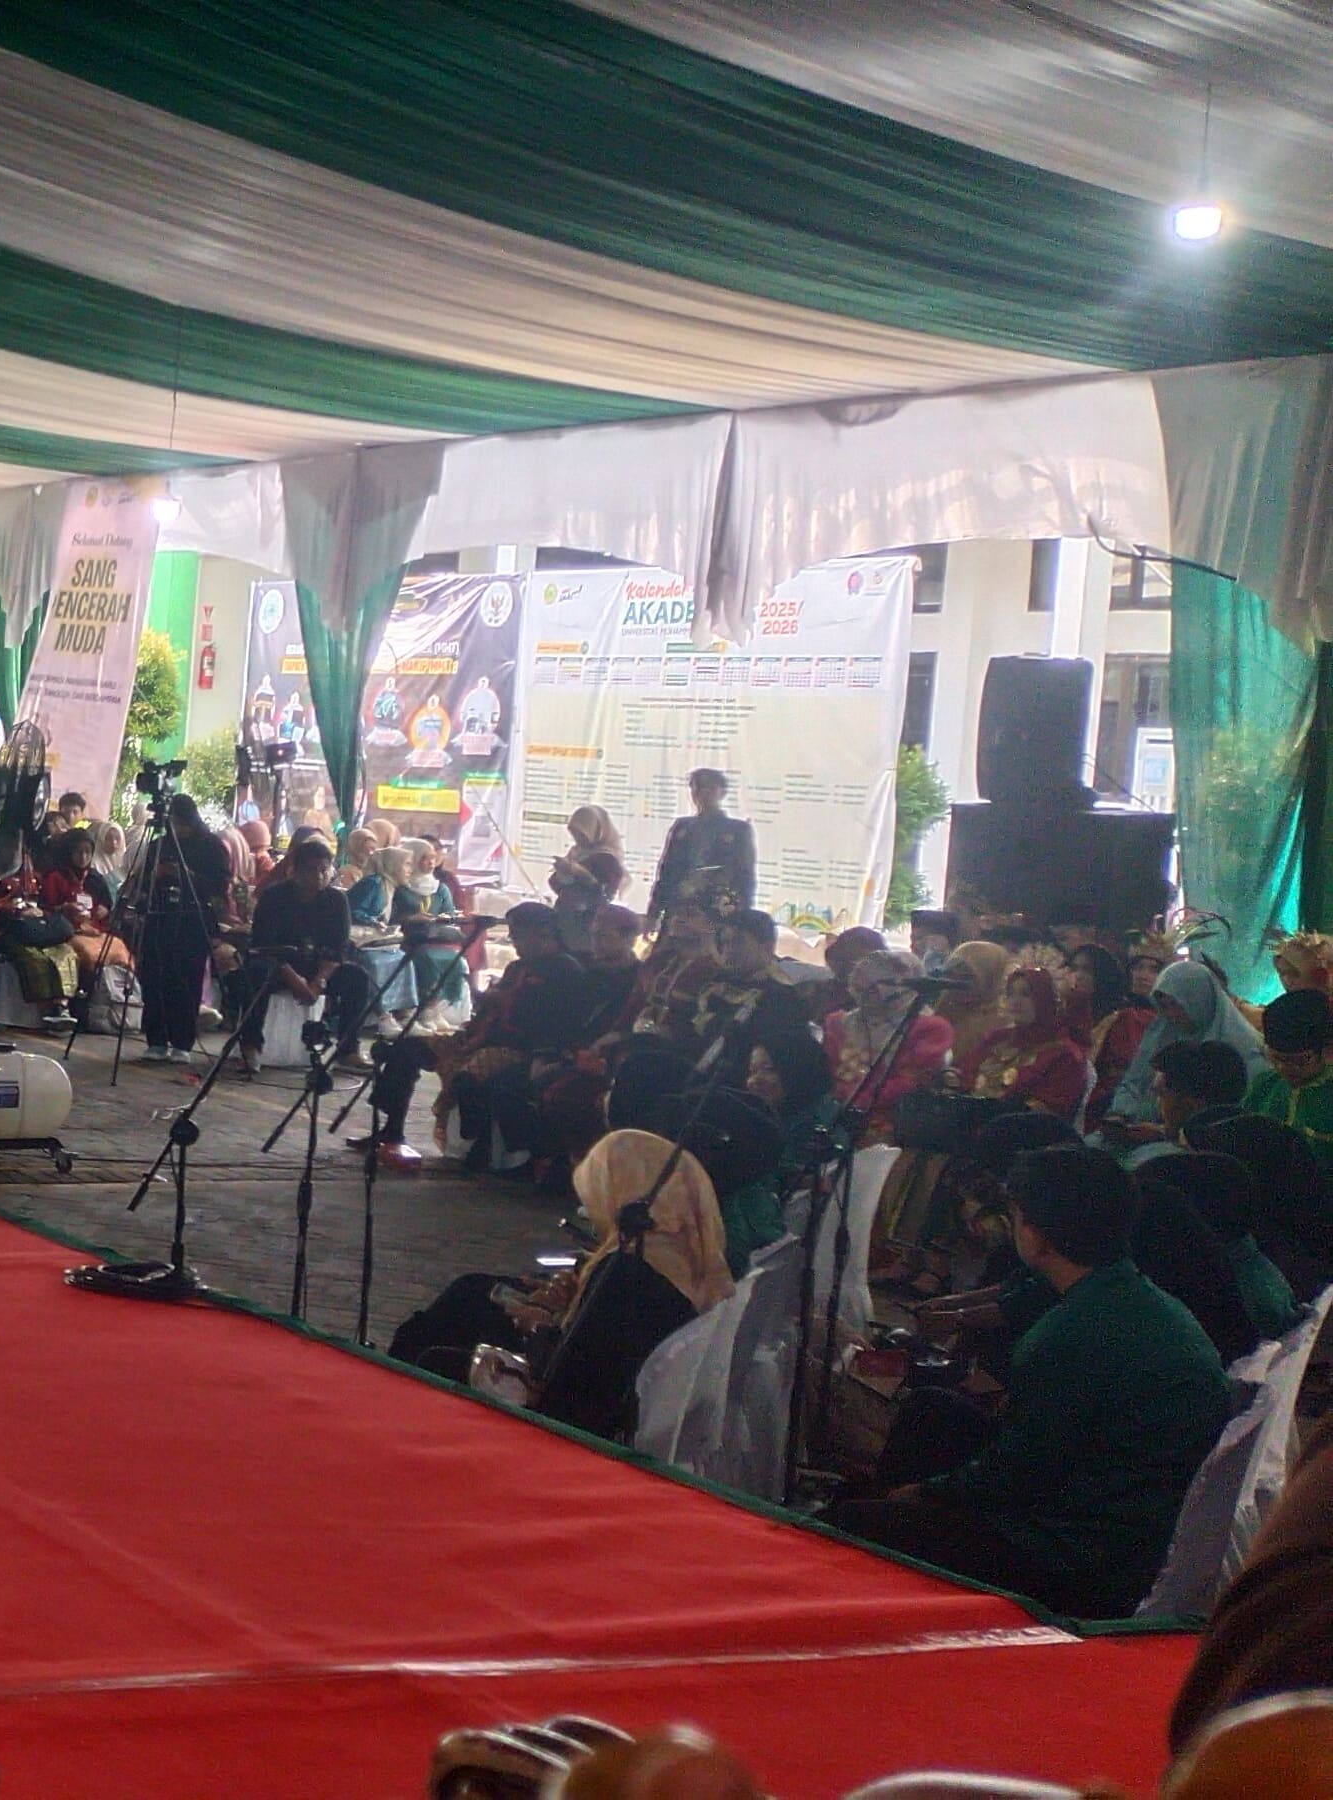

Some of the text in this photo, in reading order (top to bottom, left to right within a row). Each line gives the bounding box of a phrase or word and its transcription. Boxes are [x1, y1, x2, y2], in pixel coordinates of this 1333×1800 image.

[71, 558, 118, 588] SANG
[51, 591, 132, 623] ENCERAH
[622, 601, 694, 625] AKADE
[53, 623, 106, 655] MUDA
[762, 620, 799, 635] 2026
